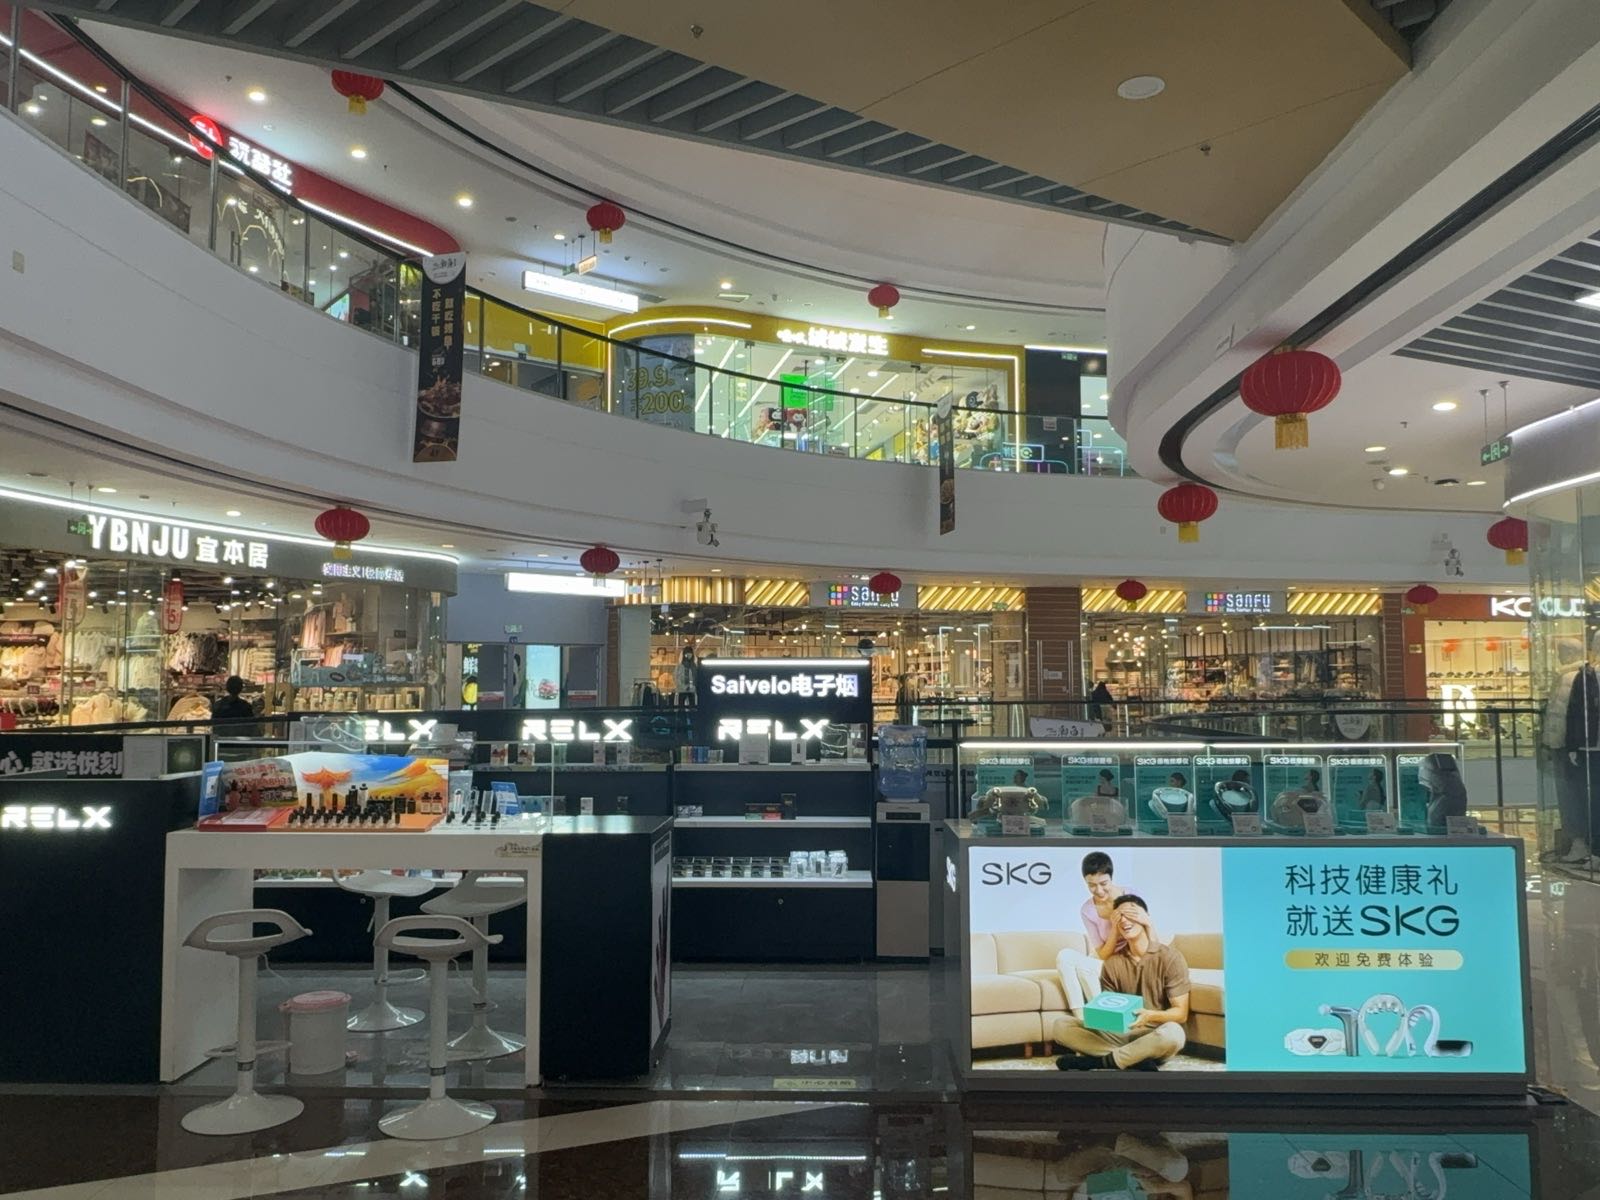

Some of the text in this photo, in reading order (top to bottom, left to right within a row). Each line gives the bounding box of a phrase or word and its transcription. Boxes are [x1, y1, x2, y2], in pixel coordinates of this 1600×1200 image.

[87, 514, 269, 569] YBNJU 宜本居
[711, 674, 859, 697] Saivelo电子烟
[522, 719, 633, 741] RELX
[1, 806, 112, 829] RELX
[982, 862, 1052, 885] SKG
[1284, 864, 1458, 896] 科技健康礼
[1286, 904, 1460, 937] 就送SKG
[1314, 952, 1434, 968] 欢迎免费体验
